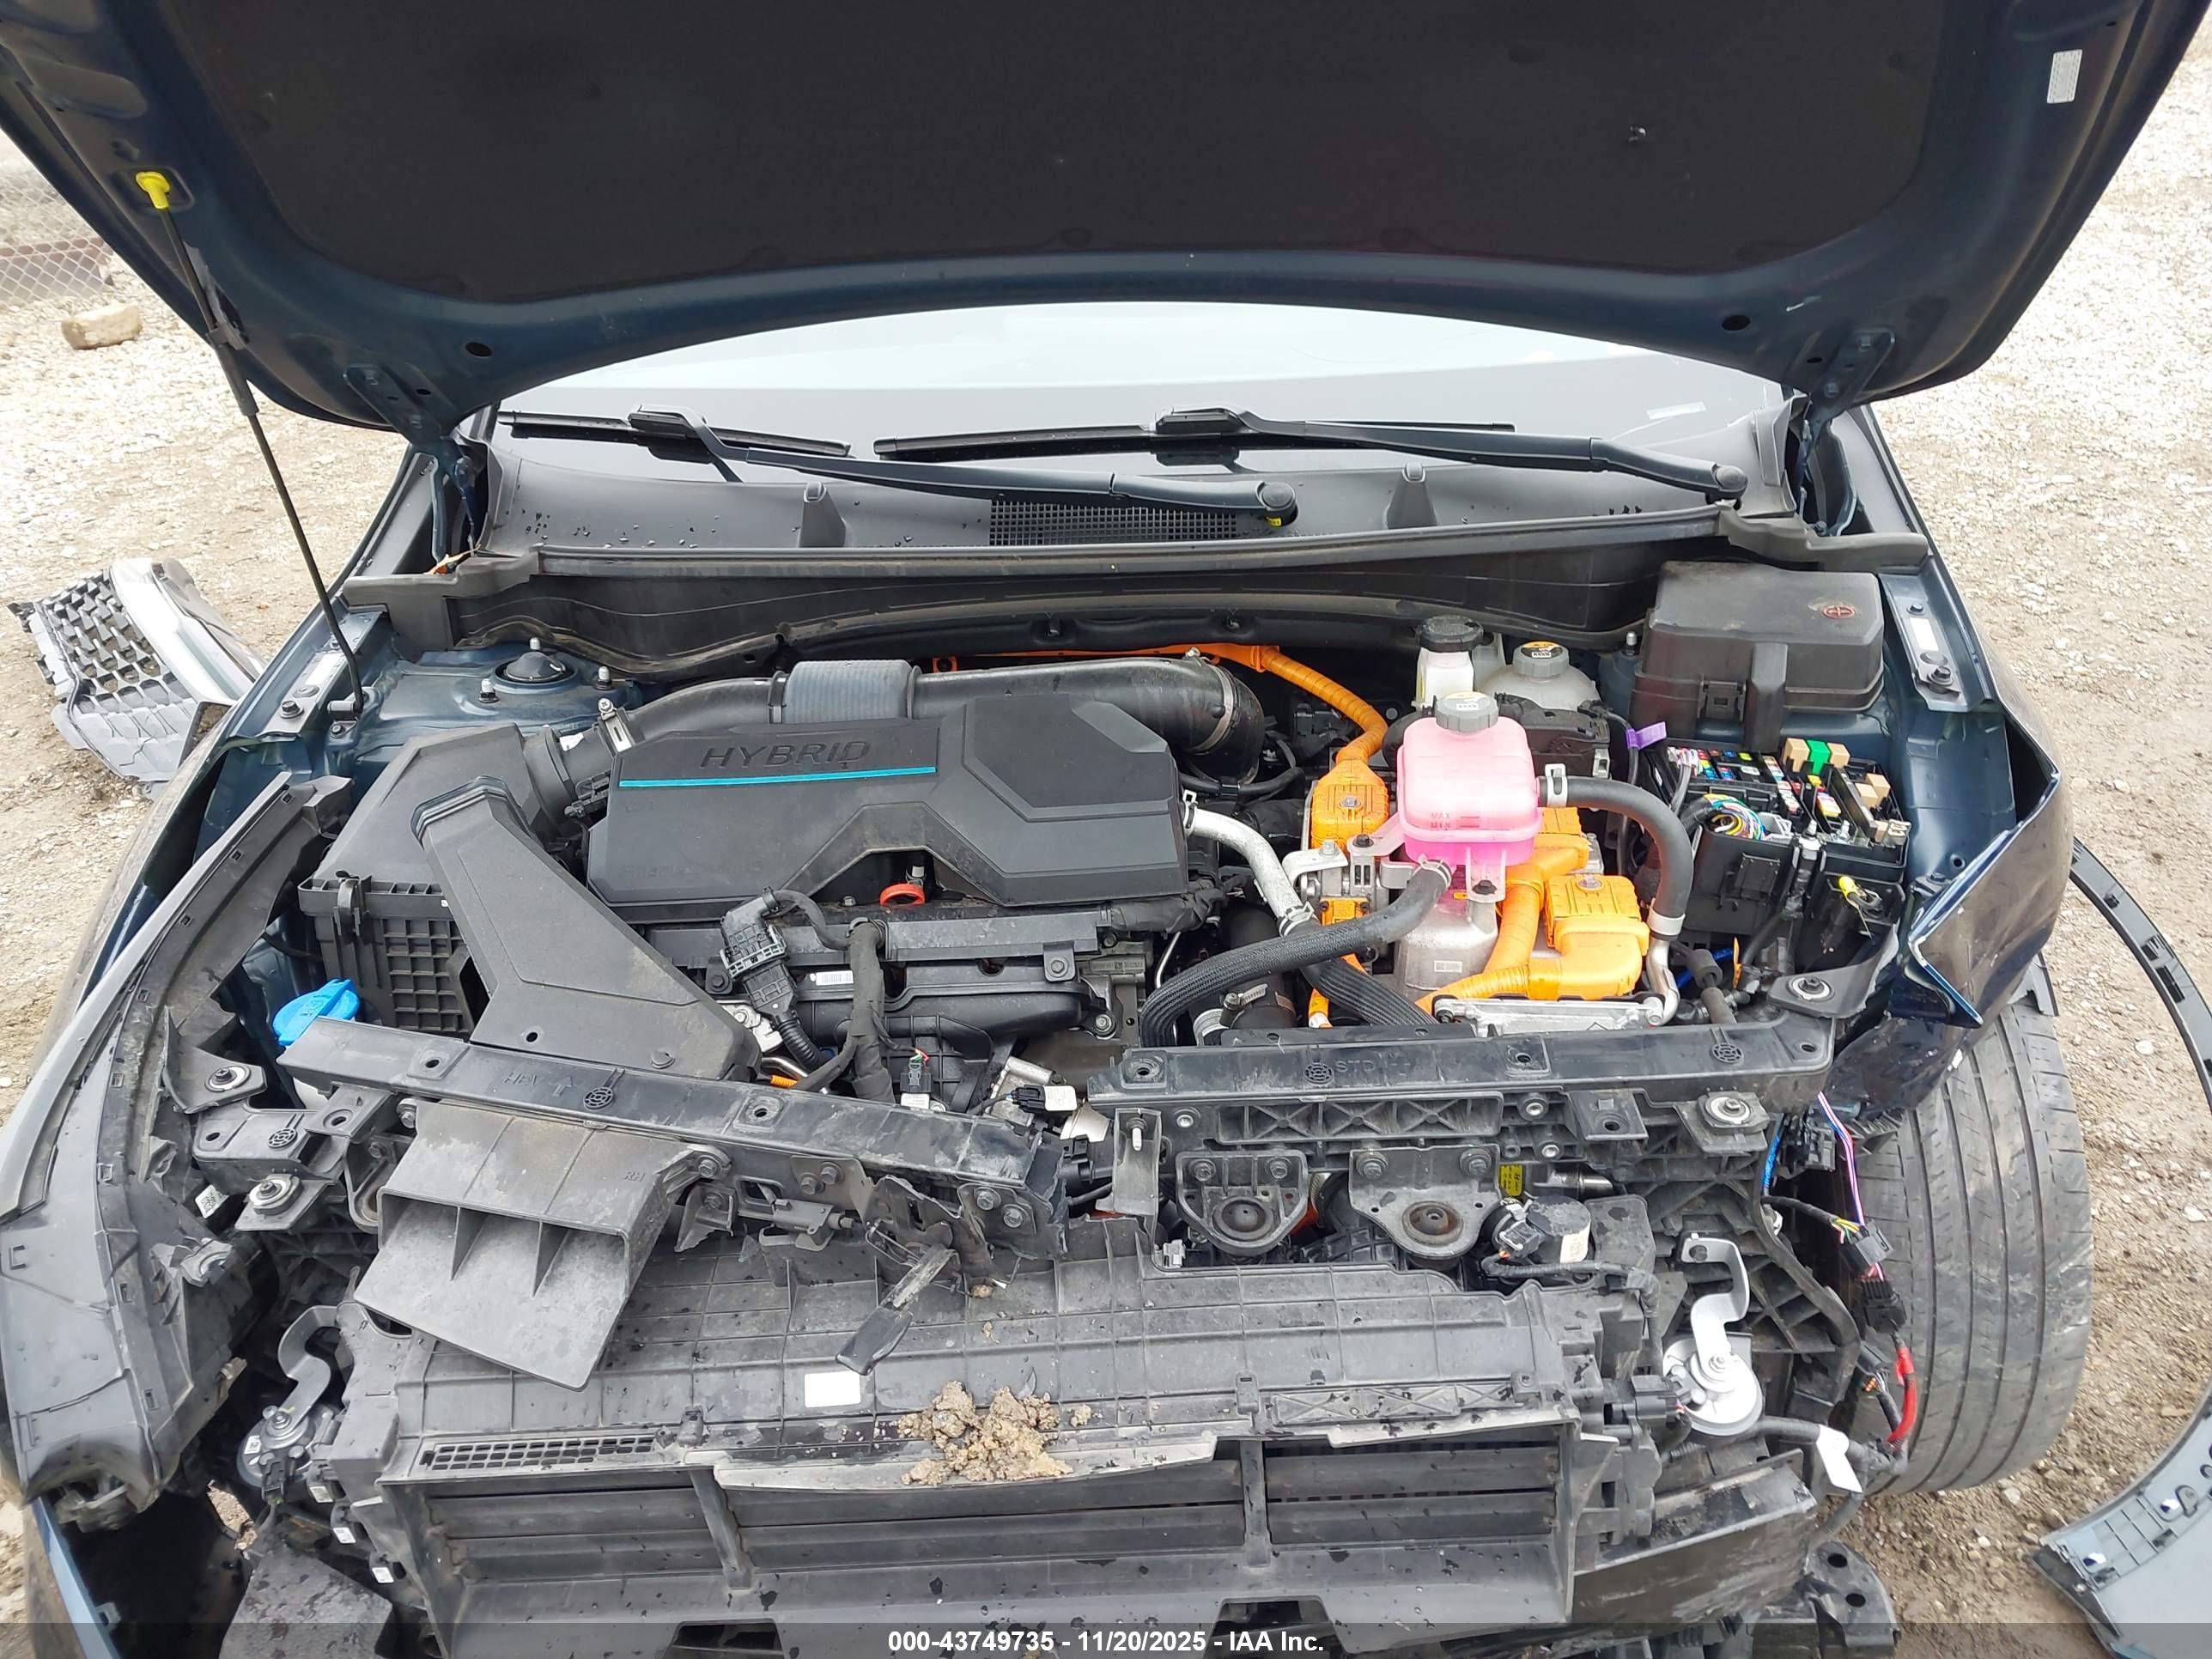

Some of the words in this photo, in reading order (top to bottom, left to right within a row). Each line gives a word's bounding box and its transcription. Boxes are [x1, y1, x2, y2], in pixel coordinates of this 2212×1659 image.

[699, 741, 872, 769] HYBRID
[1430, 811, 1451, 820] MAX
[1430, 821, 1451, 830] MIN
